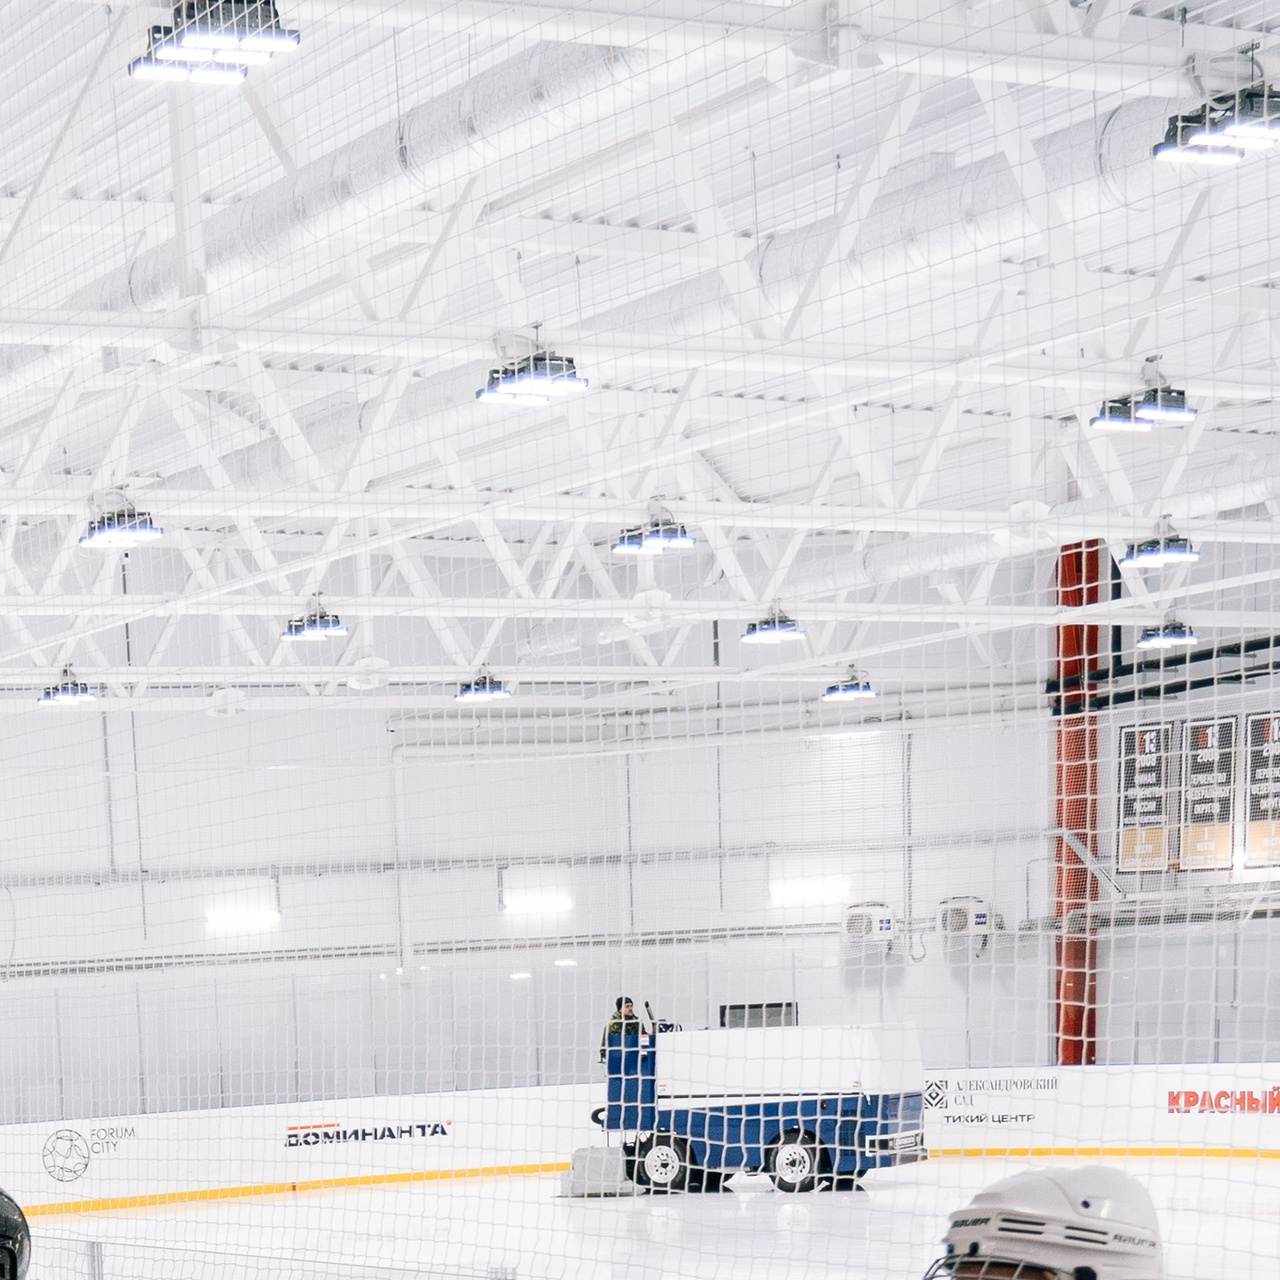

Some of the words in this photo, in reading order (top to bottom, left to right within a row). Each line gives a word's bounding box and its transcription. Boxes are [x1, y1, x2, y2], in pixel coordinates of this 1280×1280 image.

[954, 1076, 1058, 1092] АЛЕКСАНДРОВСКИЙ
[1167, 1086, 1280, 1114] КРАСНЫЙ
[944, 1112, 988, 1124] ТИХИЙ
[992, 1113, 1035, 1125] ЦЕНТР
[90, 1126, 136, 1141] FORUM
[284, 1123, 448, 1148] ДОМИНАНТА
[91, 1140, 119, 1154] CITY
